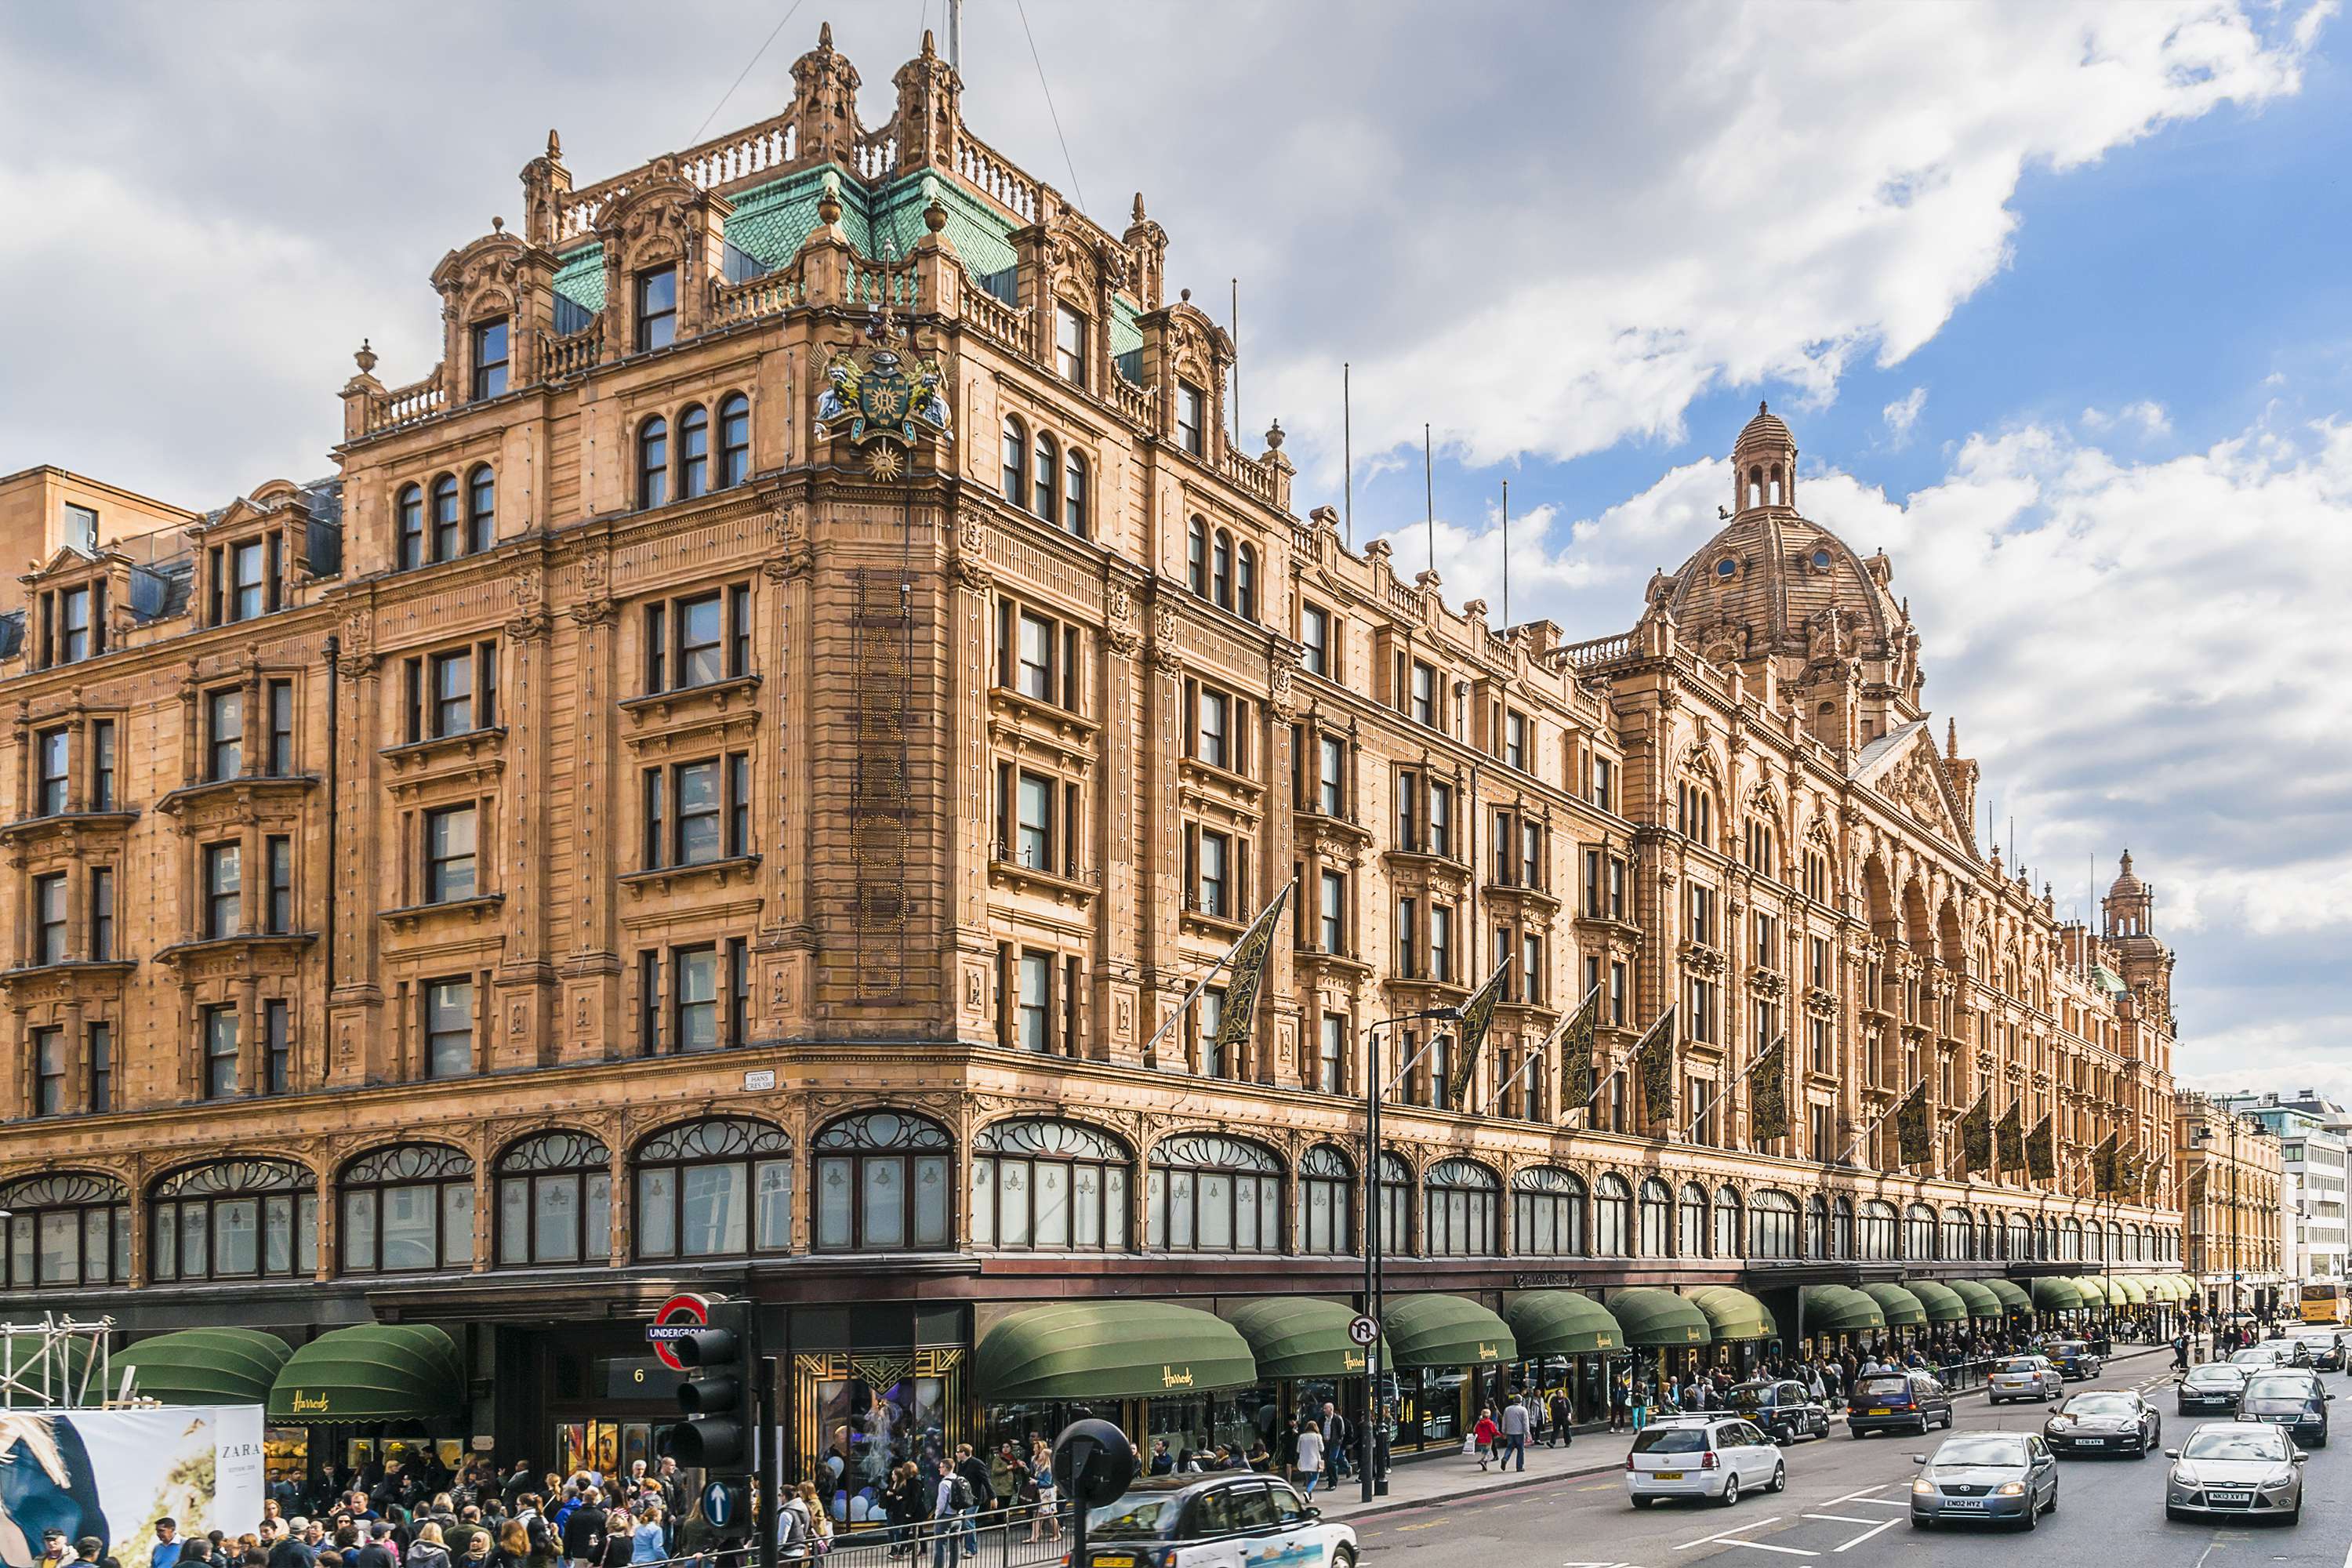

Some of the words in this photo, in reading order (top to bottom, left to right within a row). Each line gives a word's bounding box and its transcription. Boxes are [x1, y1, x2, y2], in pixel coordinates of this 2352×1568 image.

[850, 562, 910, 997] HARRODS
[1343, 1350, 1366, 1370] Harrod
[633, 1368, 644, 1382] 6
[1161, 1365, 1193, 1388] Harrods
[292, 1389, 329, 1412] Harrods
[222, 1443, 260, 1458] ZARA
